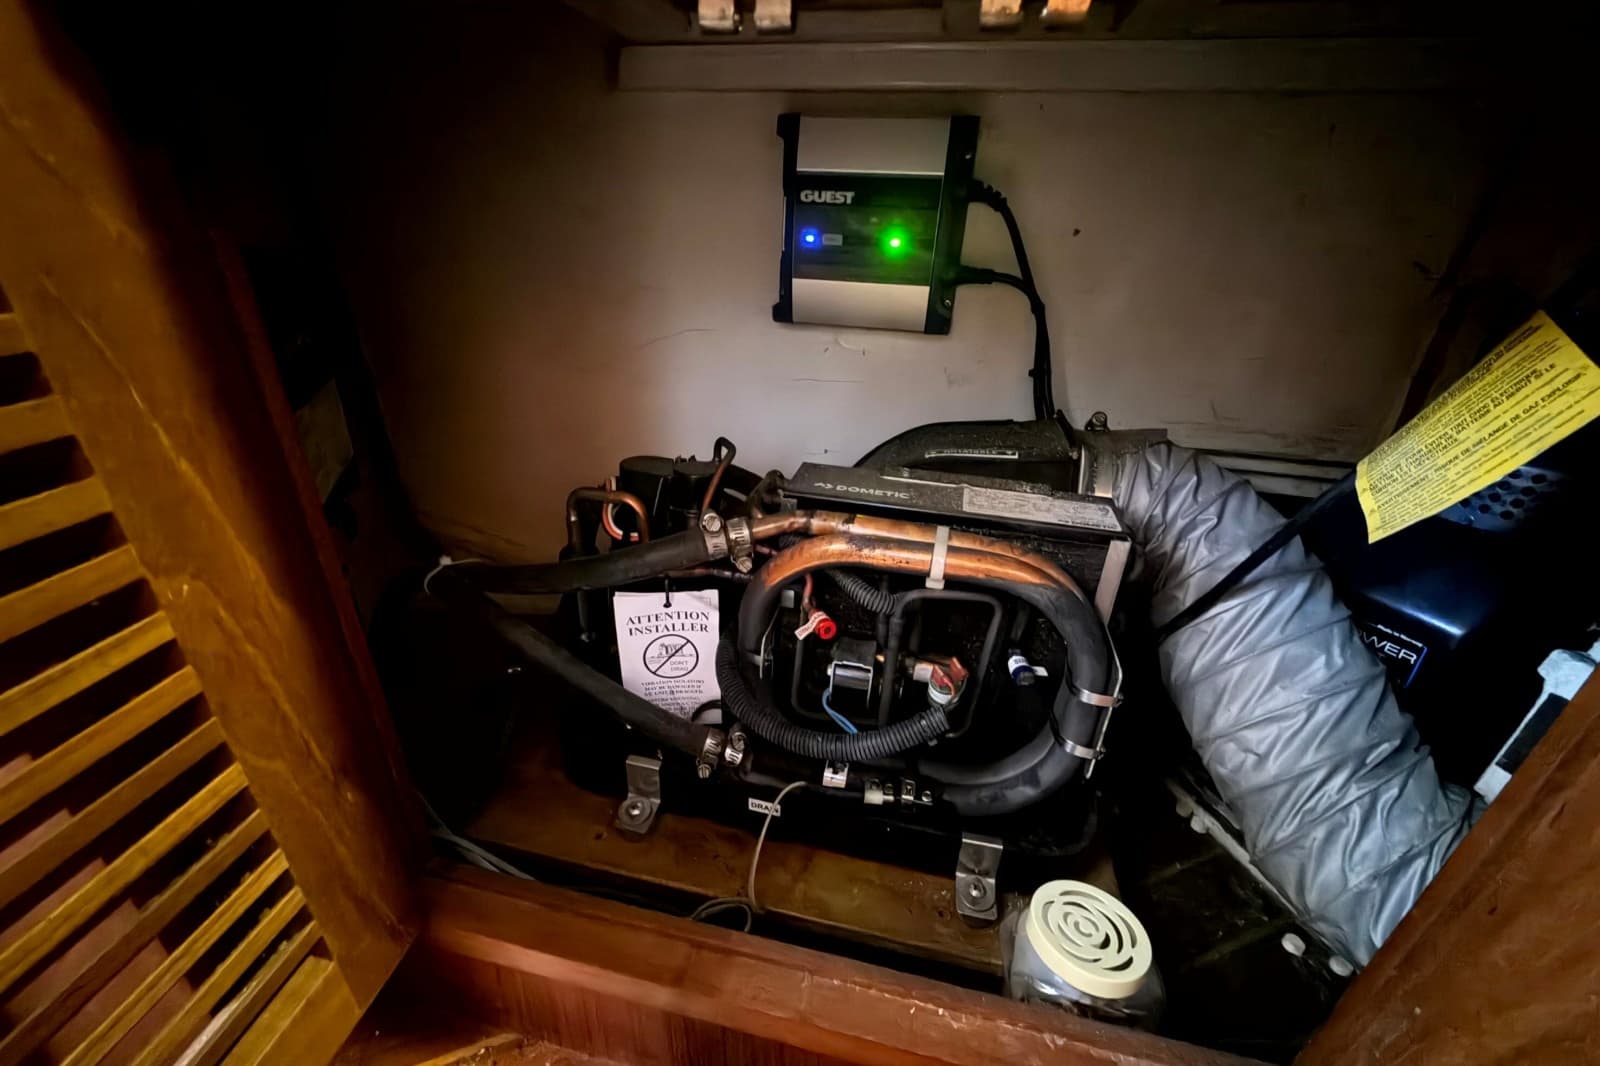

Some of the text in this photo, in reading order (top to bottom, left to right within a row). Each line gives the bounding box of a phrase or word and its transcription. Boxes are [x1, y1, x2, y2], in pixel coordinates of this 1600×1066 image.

[800, 190, 855, 205] GUEST
[836, 483, 910, 500] DOMETIC
[626, 611, 710, 626] ATTENTION
[628, 623, 710, 637] INSTALLER
[1359, 630, 1417, 664] WER
